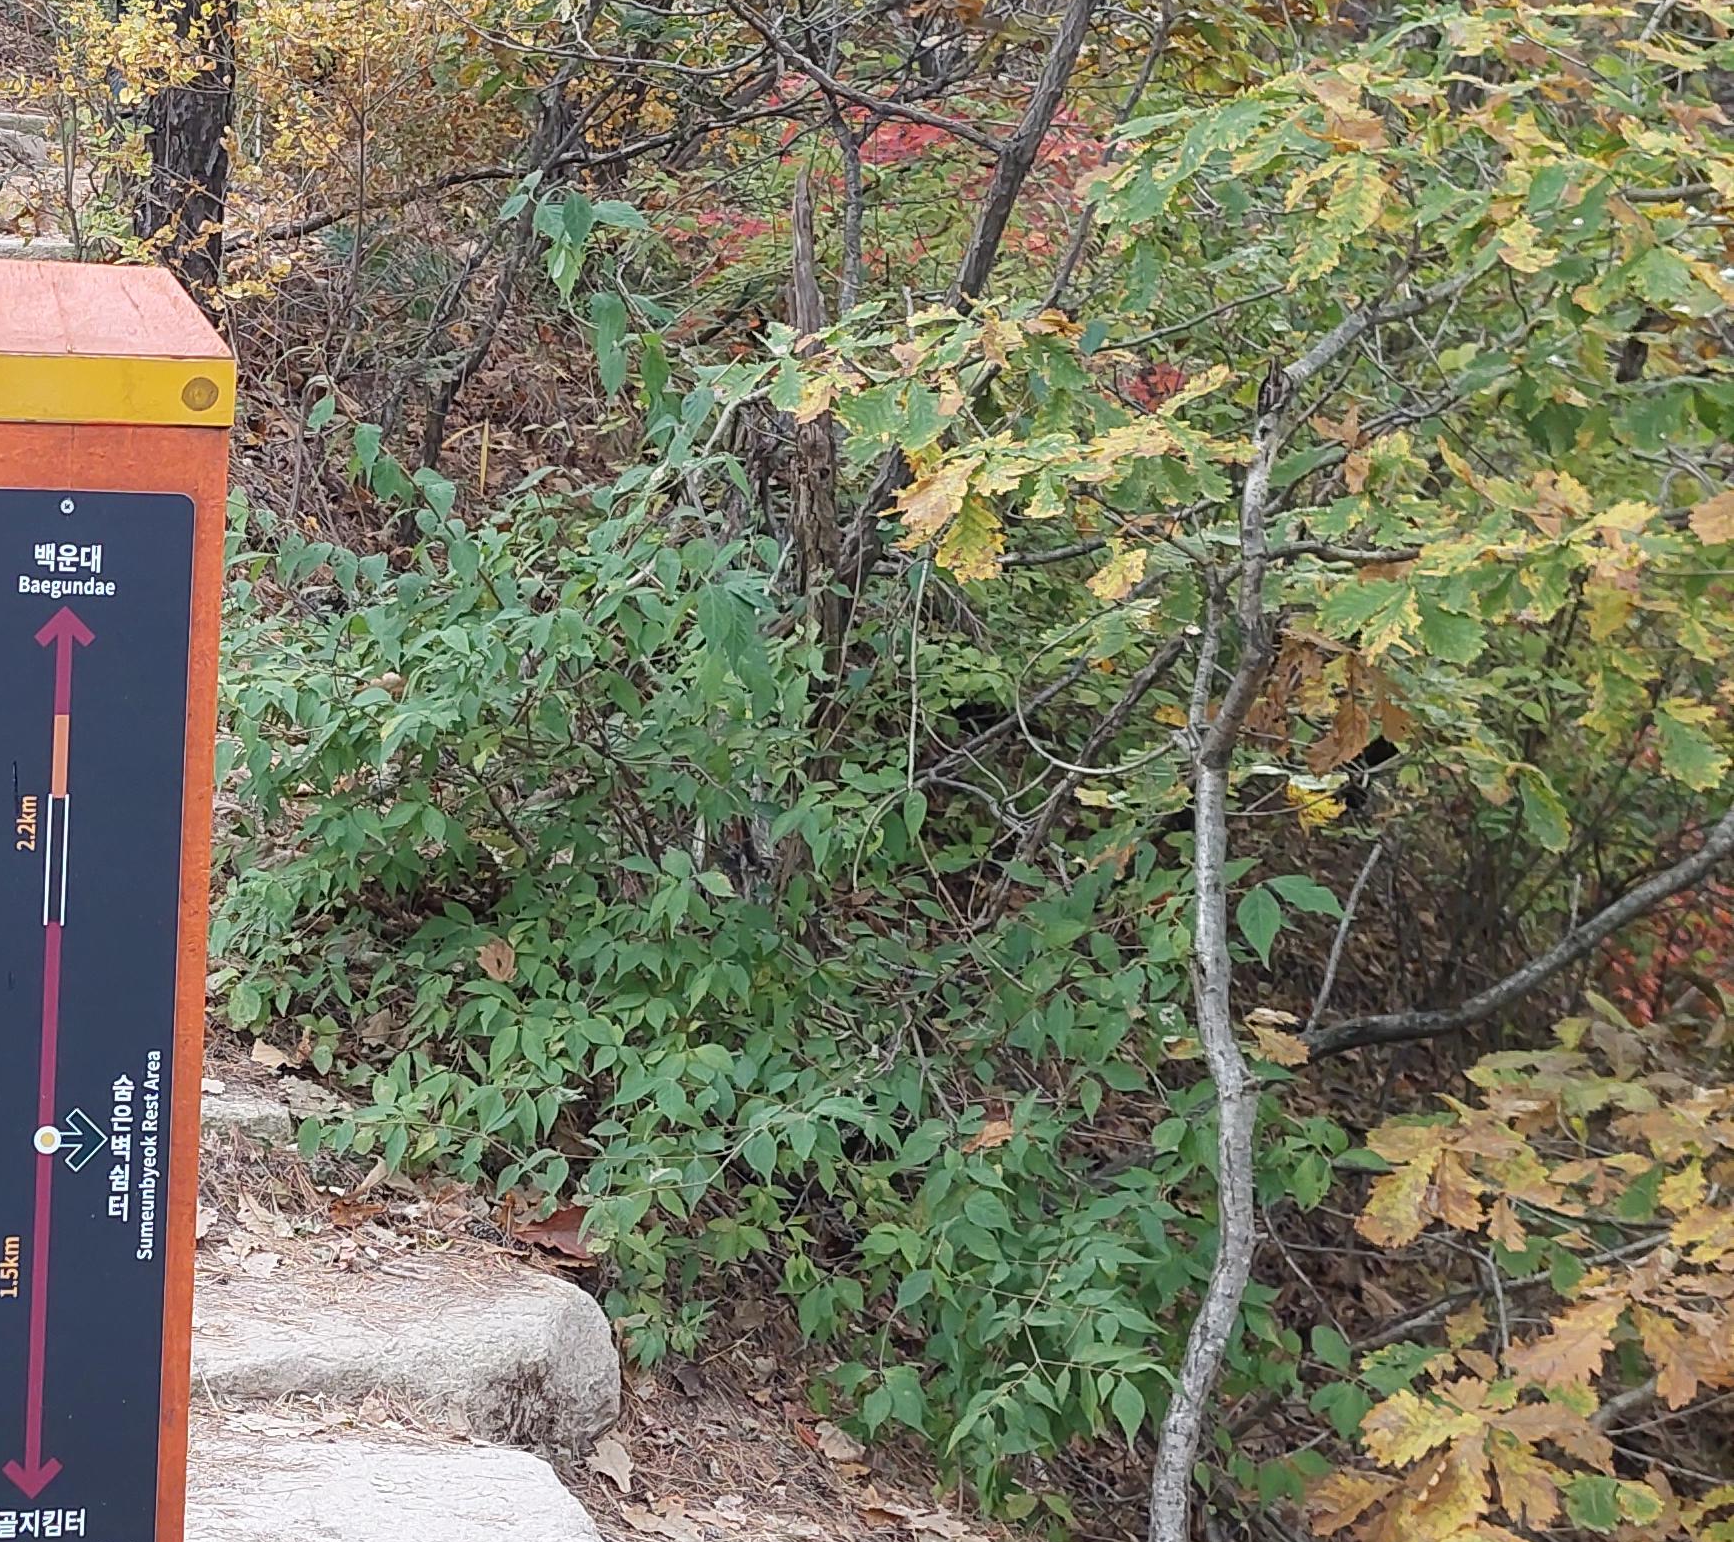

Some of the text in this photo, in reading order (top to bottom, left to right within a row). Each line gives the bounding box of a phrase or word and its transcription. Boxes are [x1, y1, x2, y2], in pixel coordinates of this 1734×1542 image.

[34, 542, 103, 573] 백운대
[18, 575, 116, 599] Baegundae
[16, 795, 38, 852] 2.2km
[136, 1050, 162, 1261] Sumeunbyeok Rest Area
